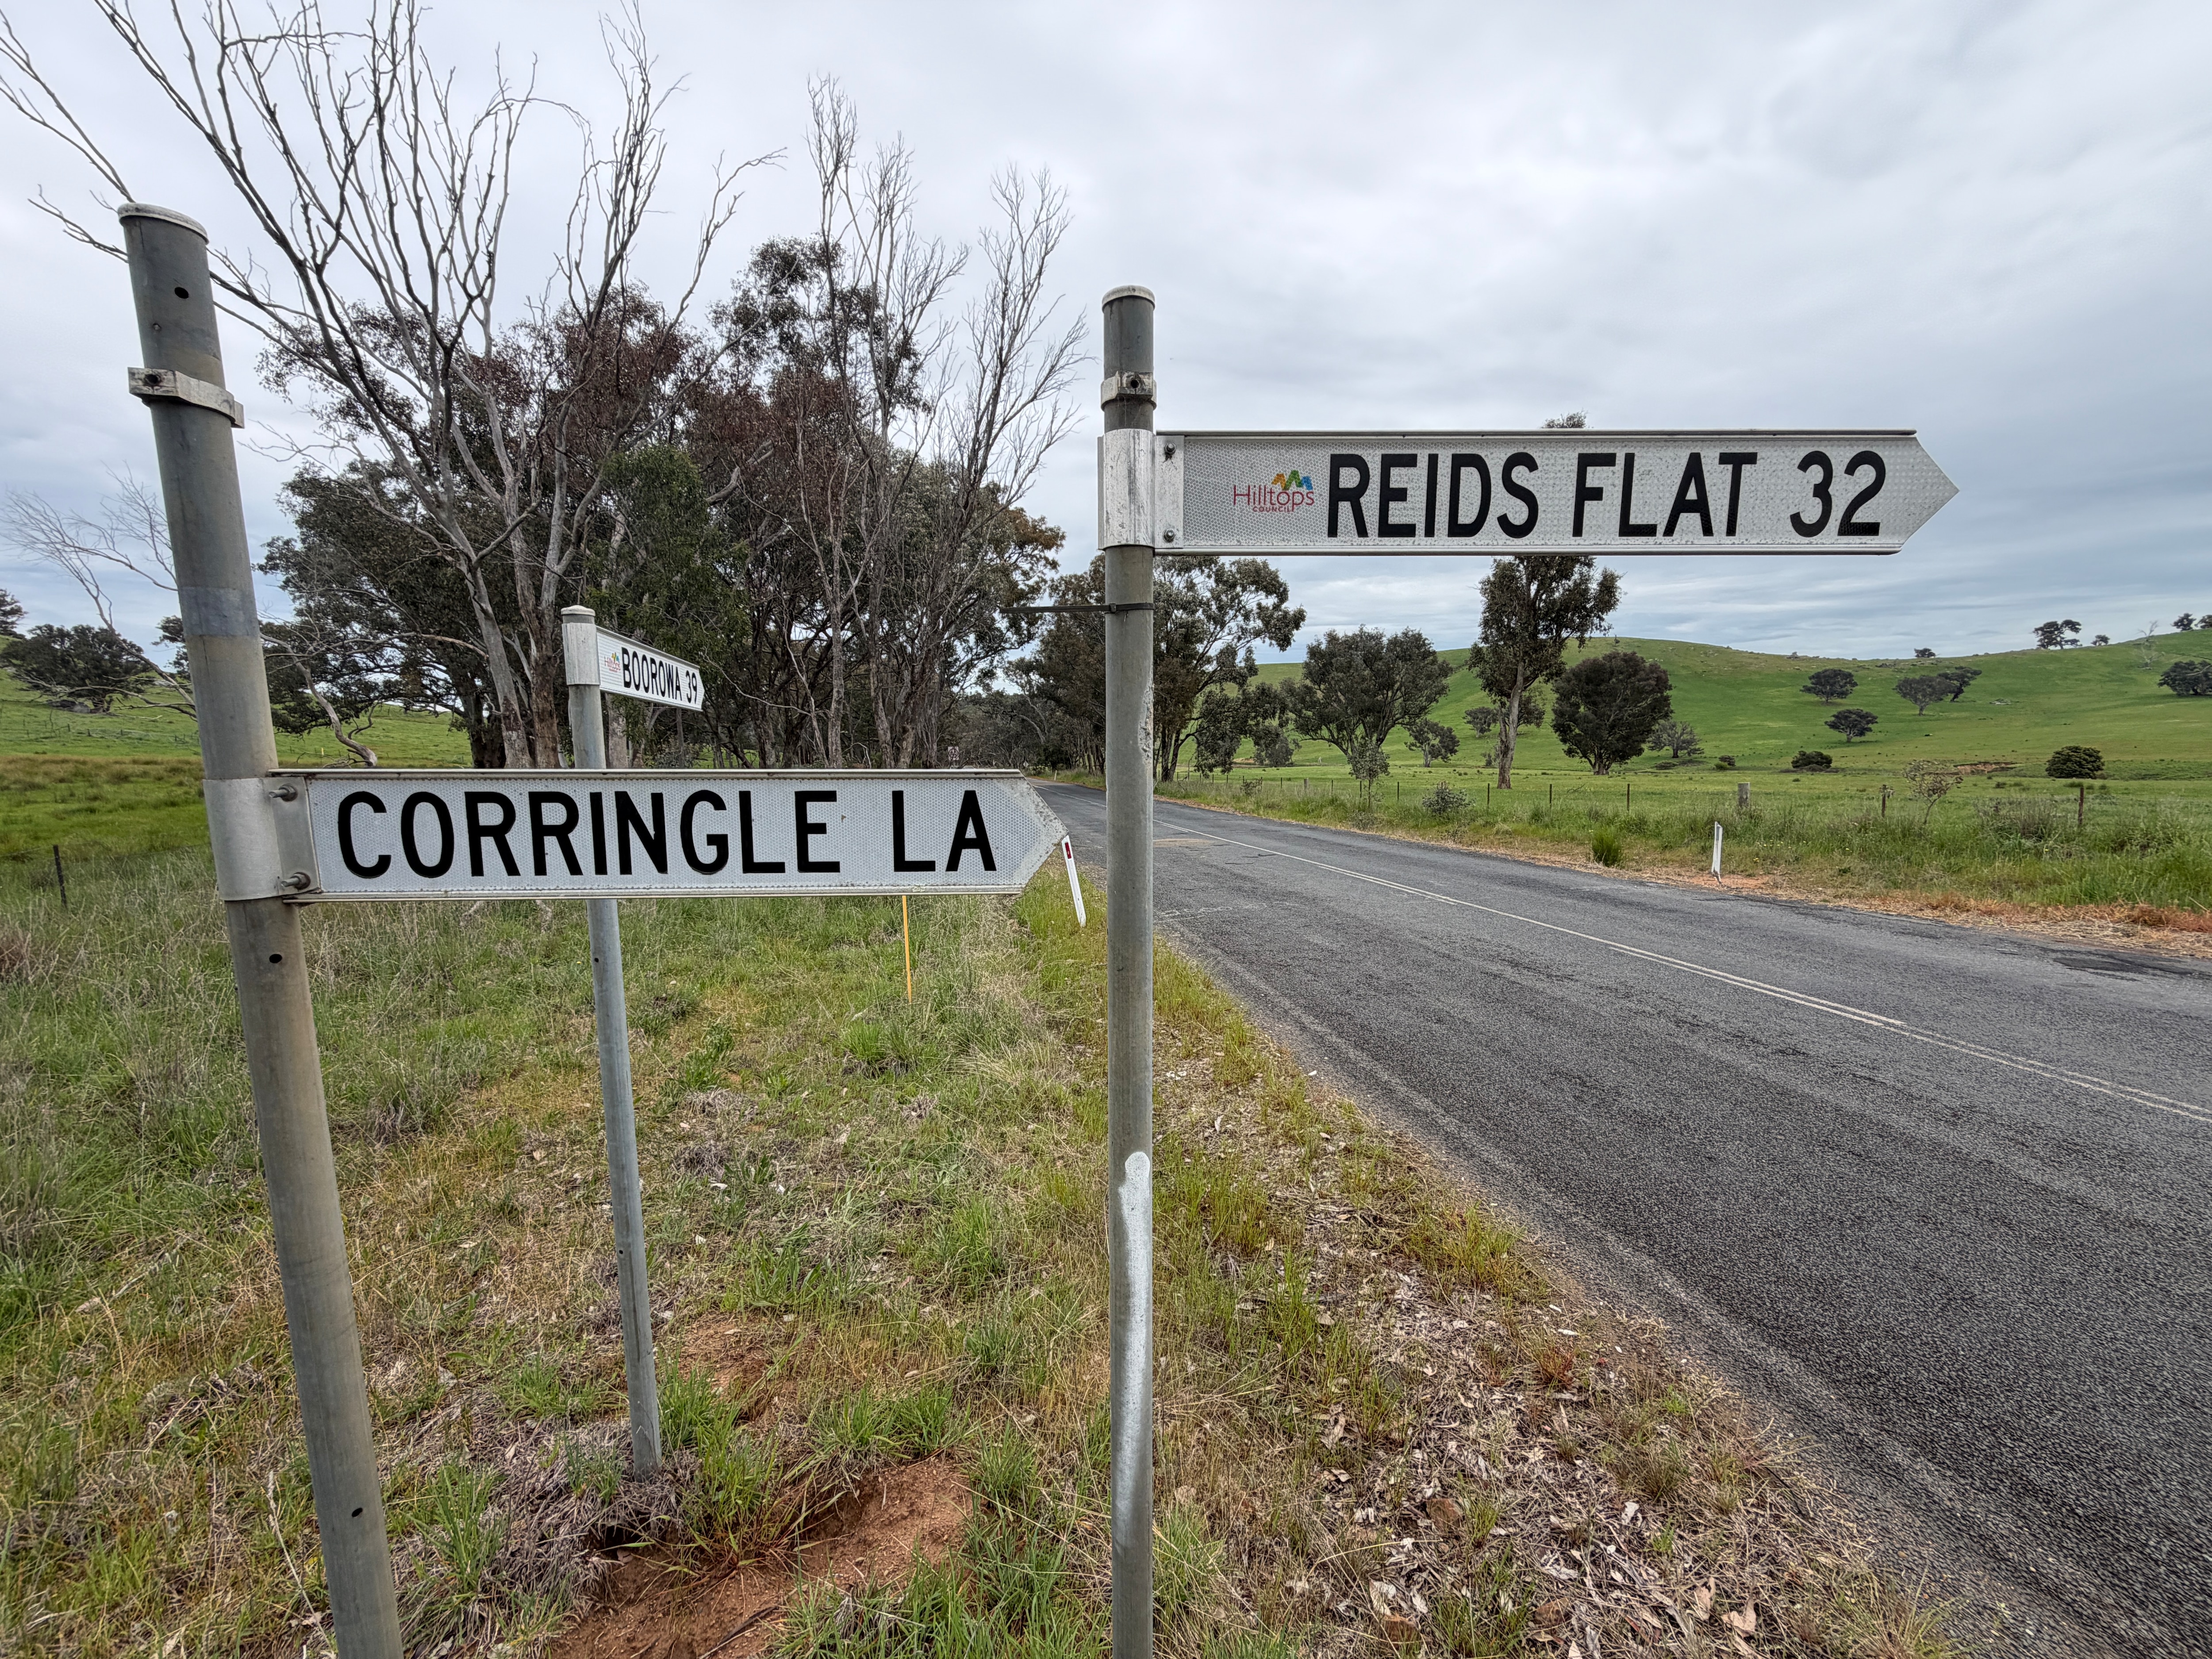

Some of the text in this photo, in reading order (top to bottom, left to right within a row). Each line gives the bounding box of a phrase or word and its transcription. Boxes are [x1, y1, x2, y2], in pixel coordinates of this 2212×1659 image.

[1233, 485, 1315, 512] Hilltops
[1327, 450, 1886, 539] REIDS FLAT 32
[621, 647, 697, 704] BOOROWA 39
[338, 789, 997, 879] CORRINGLE LA
